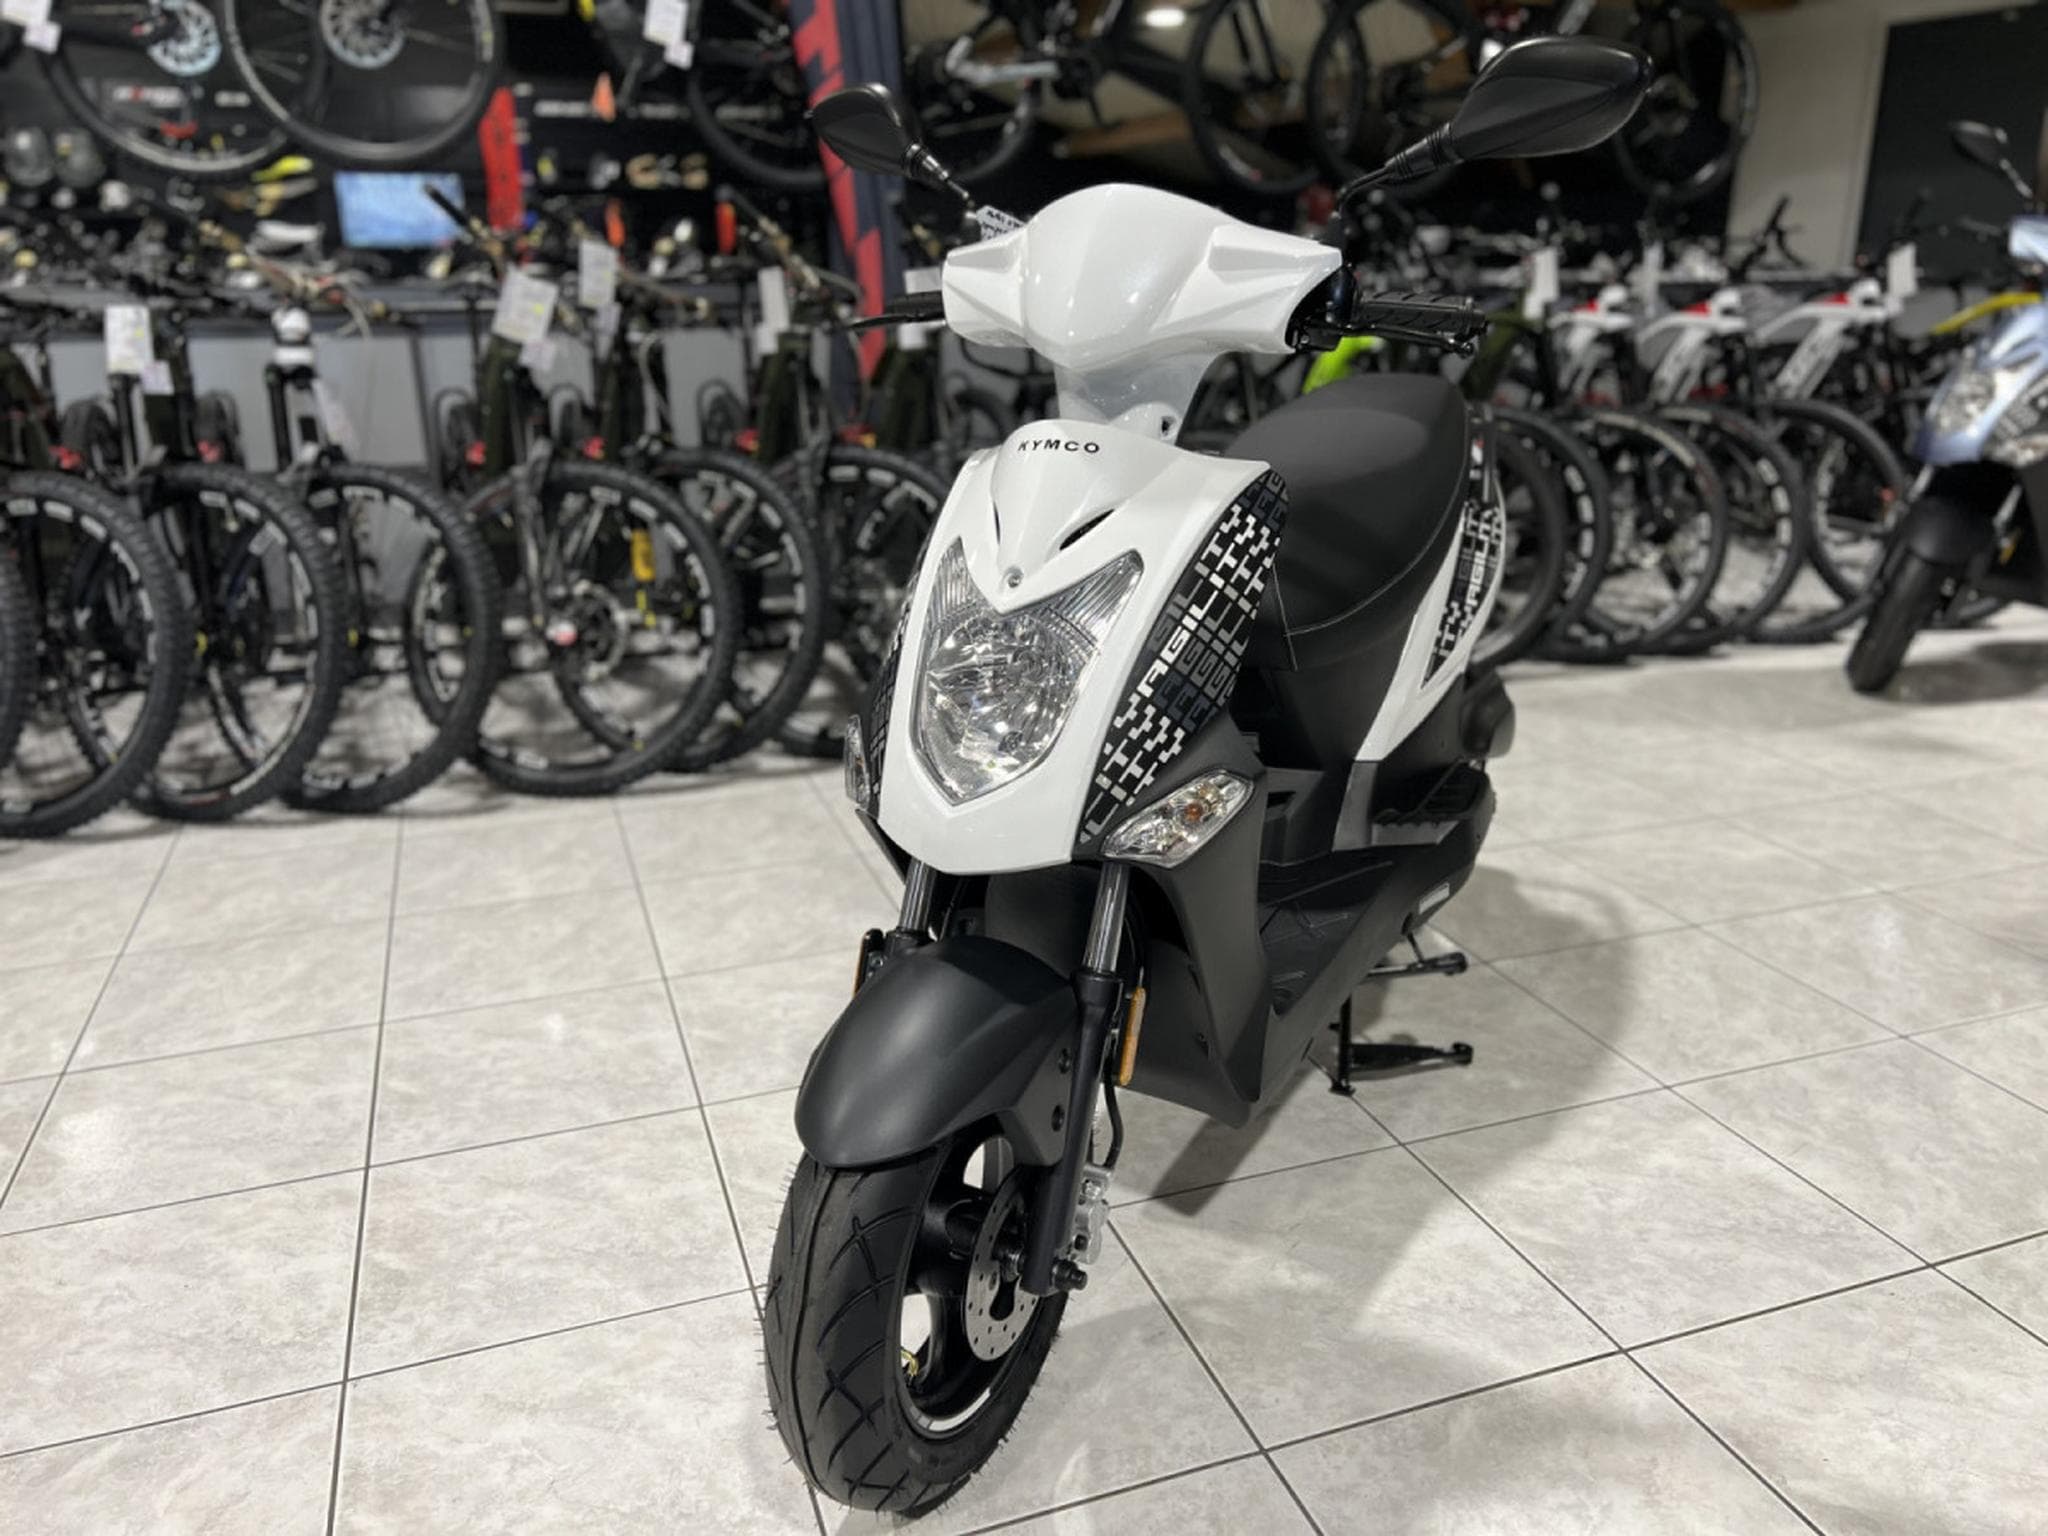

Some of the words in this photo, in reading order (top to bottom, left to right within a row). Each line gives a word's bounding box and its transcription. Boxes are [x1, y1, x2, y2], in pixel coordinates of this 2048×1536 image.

[1018, 439, 1100, 453] KYMCO
[1136, 513, 1256, 697] AGILITY
[1149, 503, 1243, 653] GILITY
[1154, 525, 1270, 710] AGILITY
